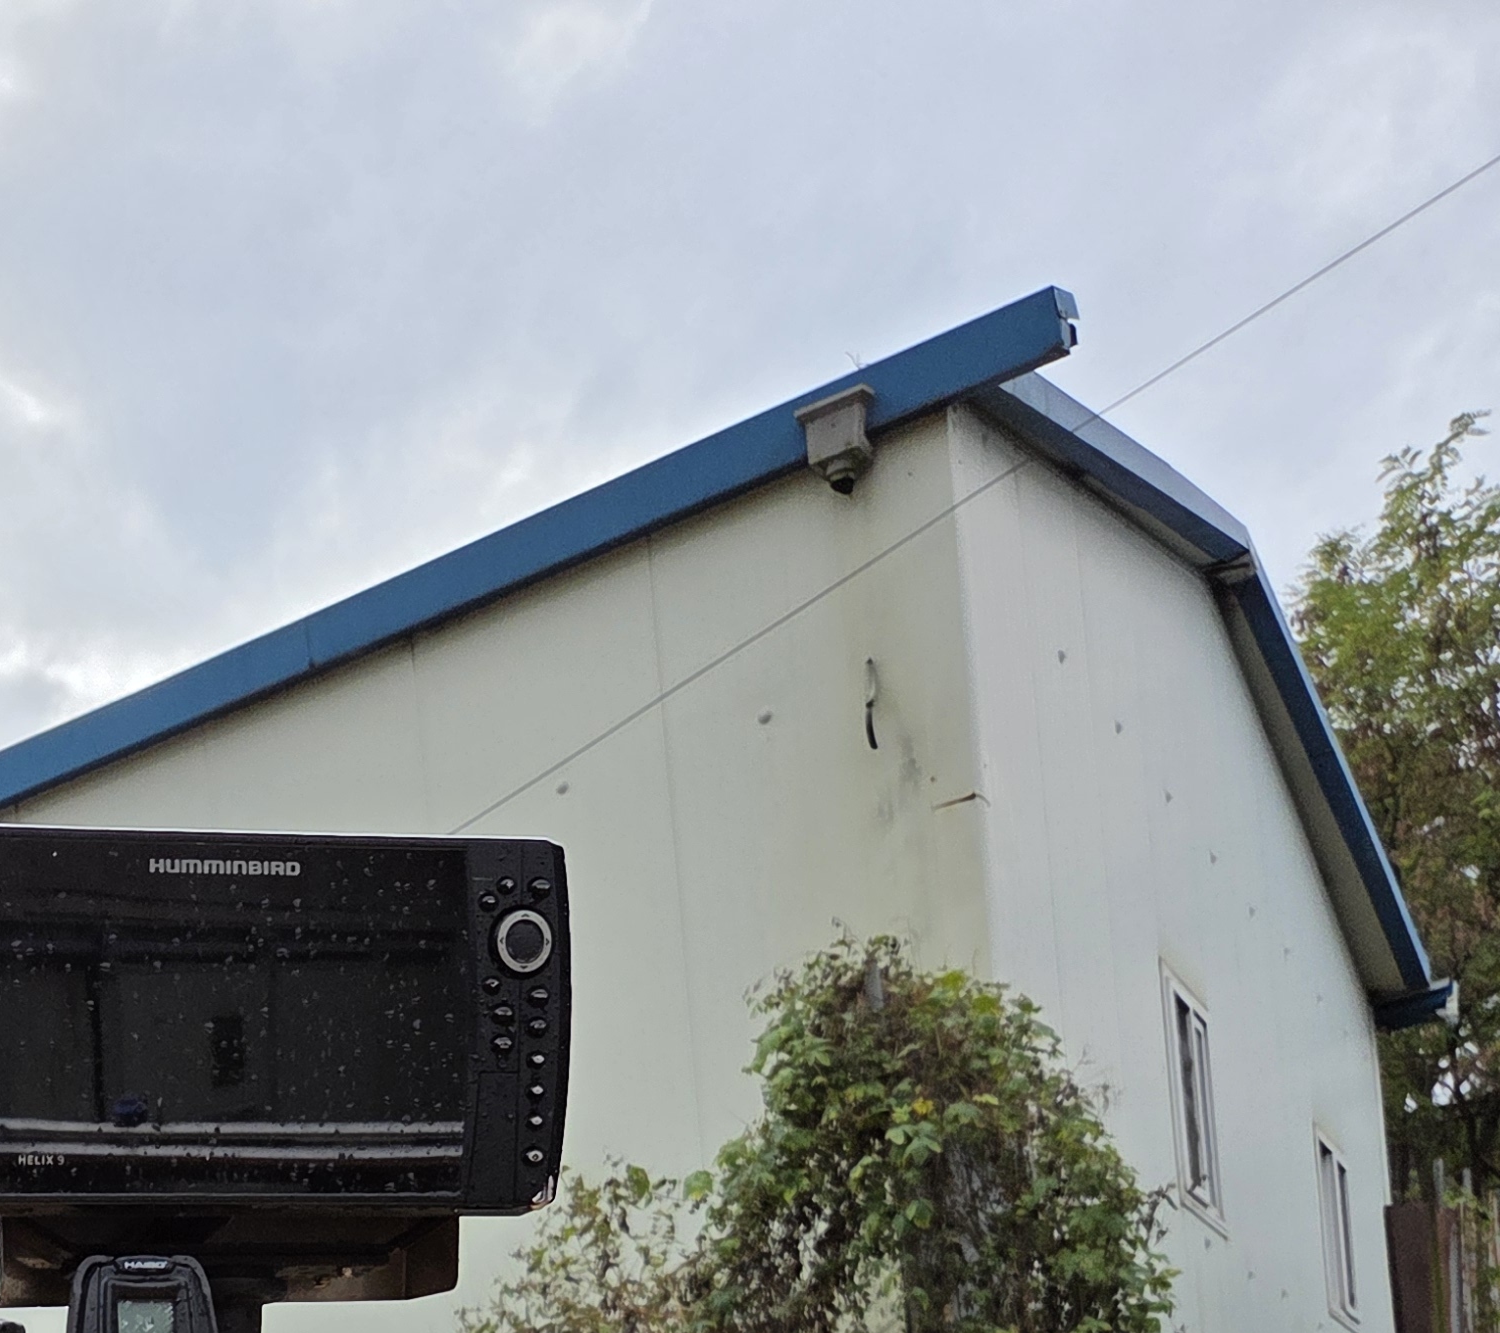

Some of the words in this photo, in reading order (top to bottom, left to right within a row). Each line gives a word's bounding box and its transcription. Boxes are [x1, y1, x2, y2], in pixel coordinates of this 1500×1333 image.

[148, 857, 301, 877] HUMMINBIRD
[17, 1154, 55, 1167] HELIX
[56, 1154, 66, 1166] 9
